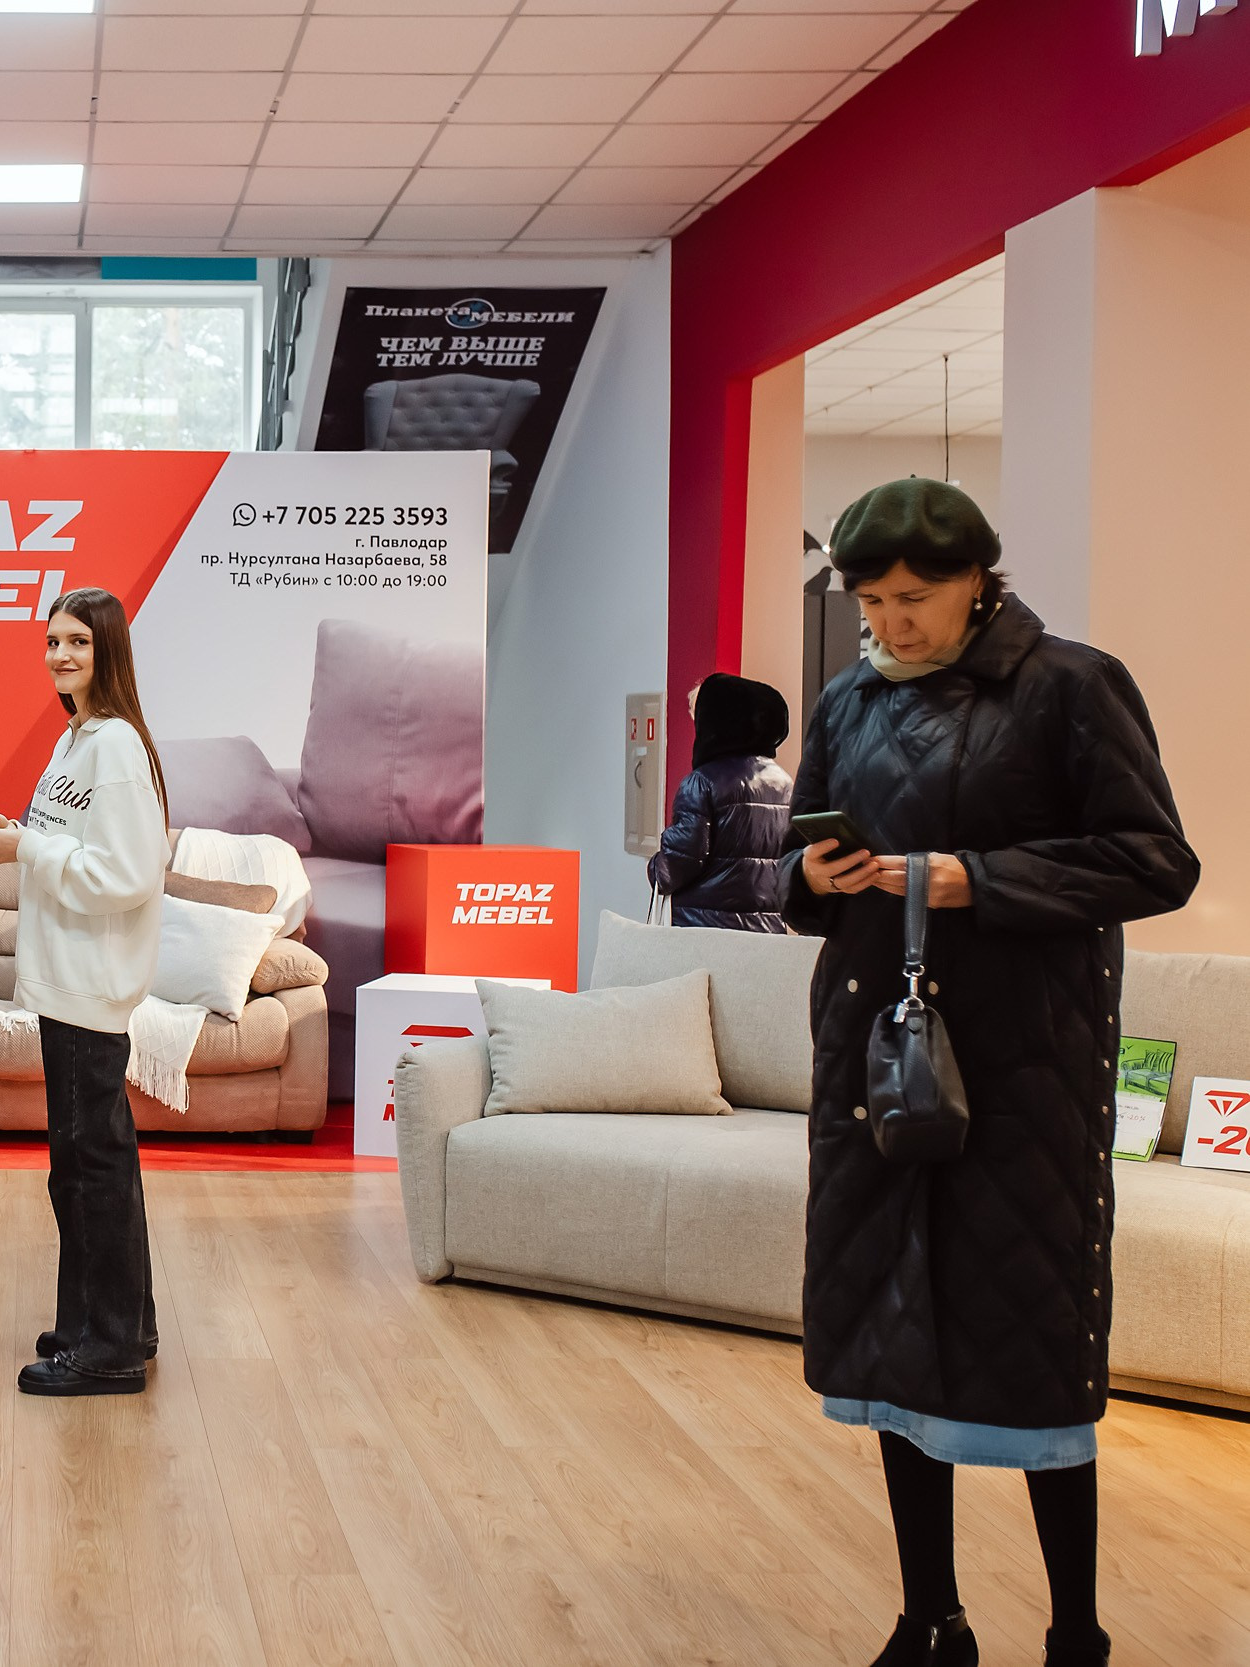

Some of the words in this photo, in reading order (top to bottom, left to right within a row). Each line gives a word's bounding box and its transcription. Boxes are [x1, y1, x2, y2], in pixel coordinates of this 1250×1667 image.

[365, 304, 471, 317] Планета
[380, 337, 443, 352] ЧЕМ
[449, 336, 545, 351] ВЫШЕ
[377, 352, 431, 367] ТЕМ
[438, 352, 540, 367] ЛУЧШЕ
[262, 506, 288, 525] +7
[295, 506, 337, 525] 705
[344, 506, 385, 526] 225
[392, 506, 448, 526] 3593
[355, 538, 365, 549] г.
[370, 536, 448, 552] Павлодар
[201, 554, 223, 568] пр.
[228, 552, 320, 568] Нурсултана
[325, 553, 425, 569] Назарбаева,
[430, 554, 448, 566] 58
[230, 573, 251, 587] ТД
[255, 572, 319, 588] «Рубин»
[337, 574, 378, 586] 10:00
[382, 577, 402, 588] до
[406, 574, 447, 587] 19:00
[49, 775, 93, 811] Club
[456, 883, 555, 902] TOPAZ
[452, 906, 554, 925] MEBEL
